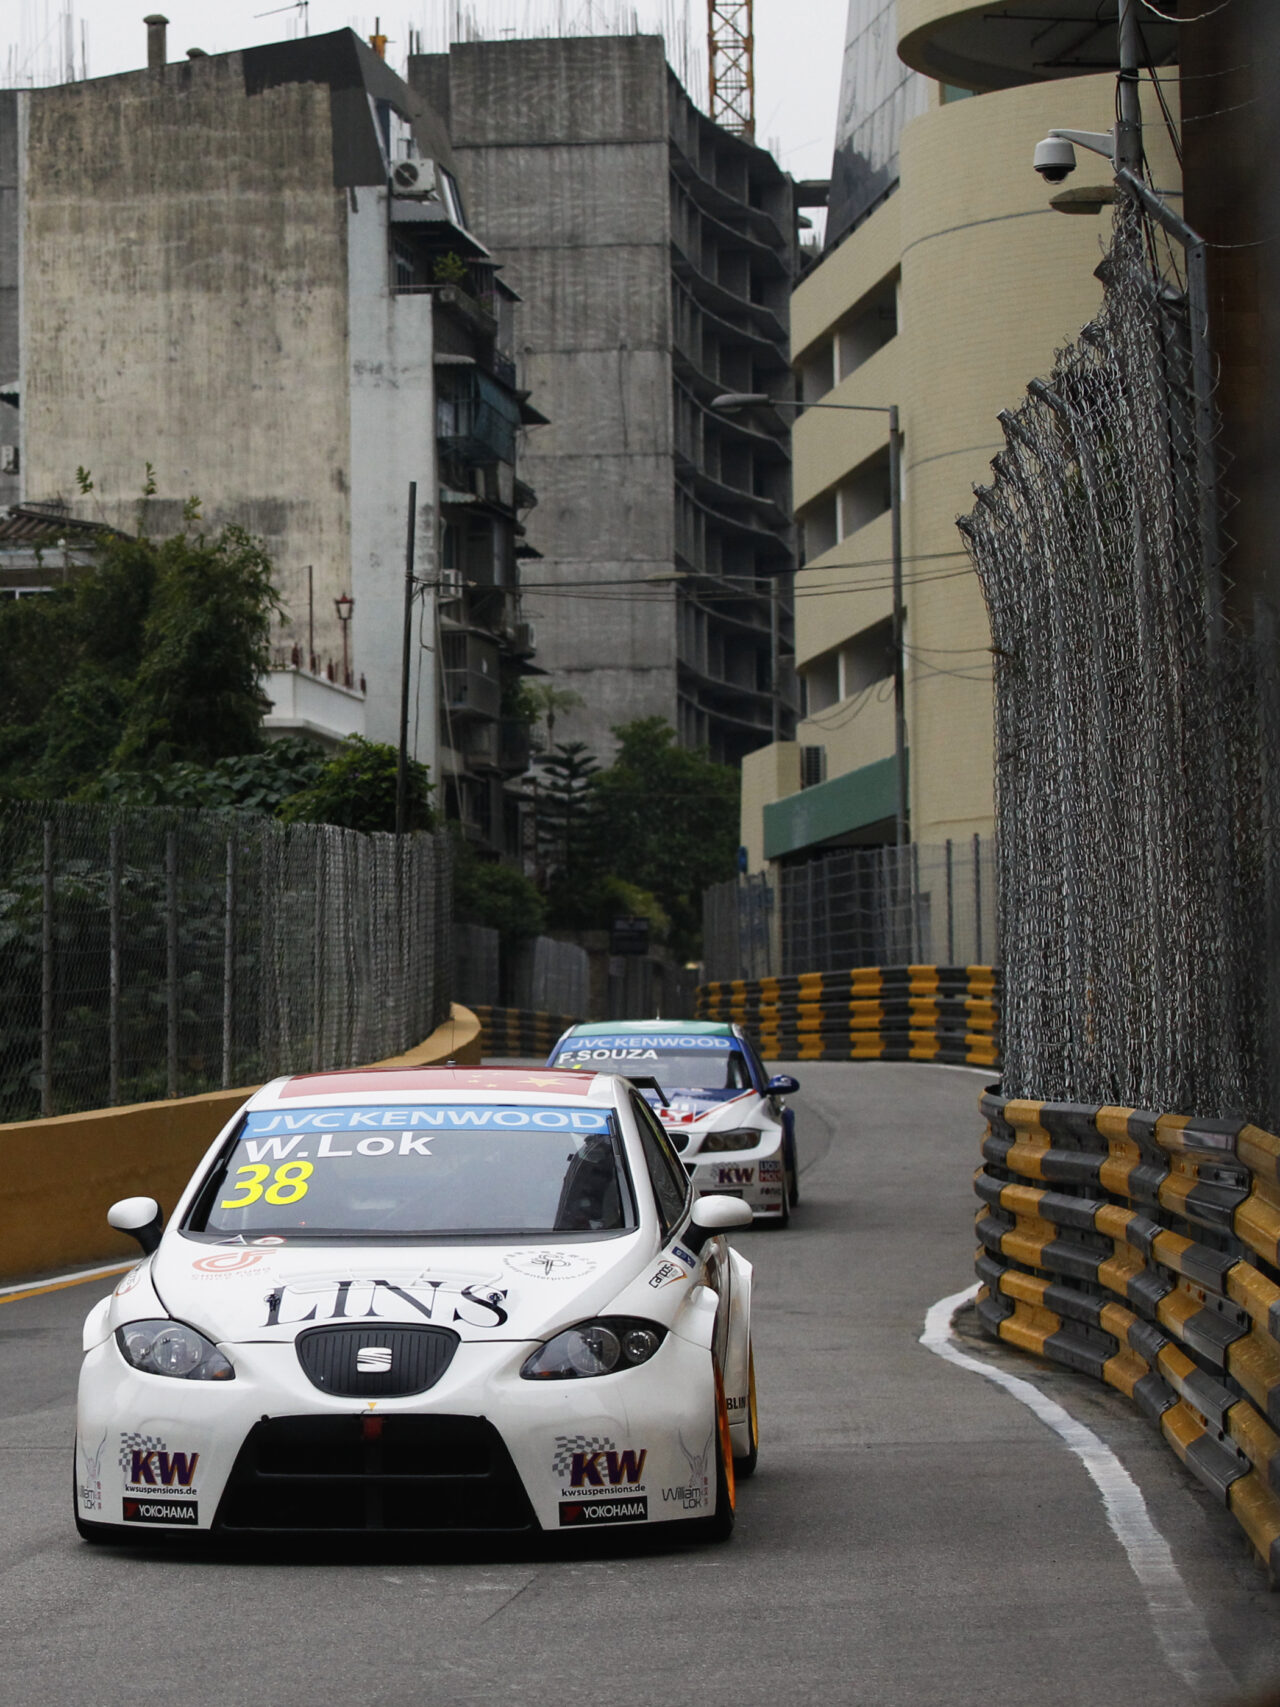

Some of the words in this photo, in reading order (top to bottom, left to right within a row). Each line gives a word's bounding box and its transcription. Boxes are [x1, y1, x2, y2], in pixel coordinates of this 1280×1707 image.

[221, 1161, 314, 1209] 38
[259, 1280, 508, 1328] LINS
[131, 1449, 199, 1486] KW
[570, 1449, 648, 1488] KW
[125, 1484, 198, 1496] kwsuspensions.de
[561, 1484, 646, 1497] kwsuspensions.de
[138, 1504, 196, 1519] YOKOHAMA
[583, 1502, 646, 1519] YOKOHAMA
